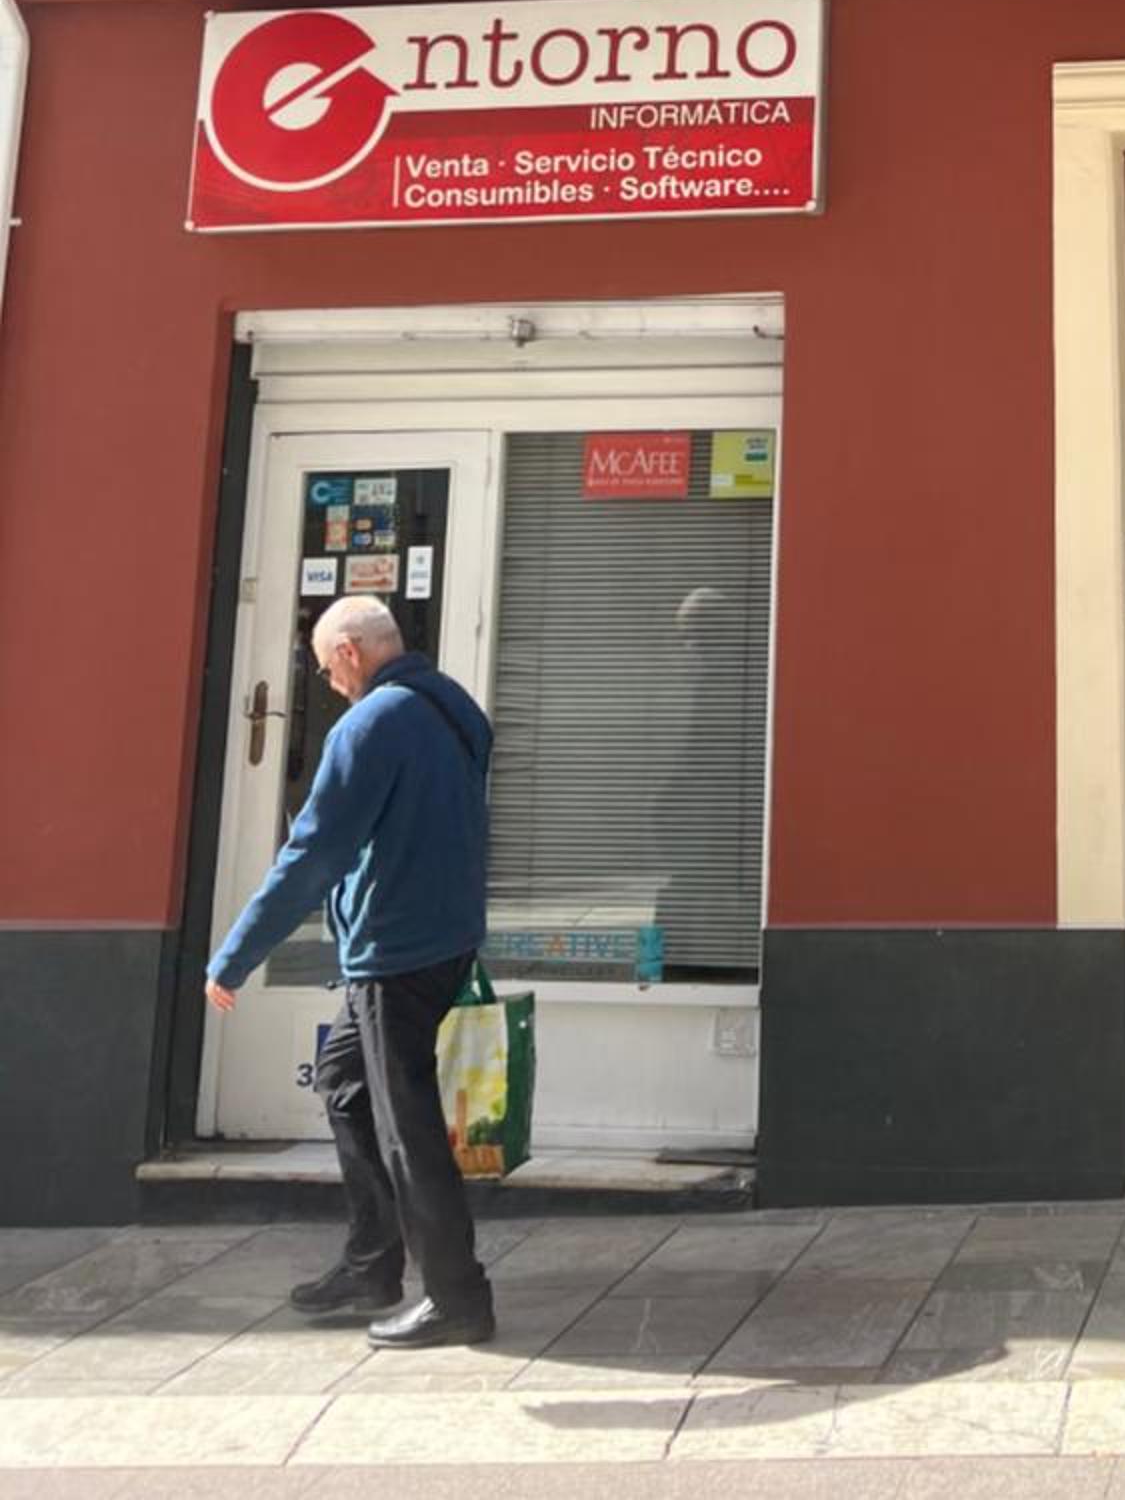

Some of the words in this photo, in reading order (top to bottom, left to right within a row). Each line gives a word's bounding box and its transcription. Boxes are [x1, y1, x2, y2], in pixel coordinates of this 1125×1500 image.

[590, 96, 790, 130] INFORMÁTICA
[405, 153, 489, 178] Venta
[514, 147, 634, 176] Servicio
[643, 143, 762, 170] Técnico
[404, 180, 594, 208] Consumibles
[619, 174, 790, 200] Software....
